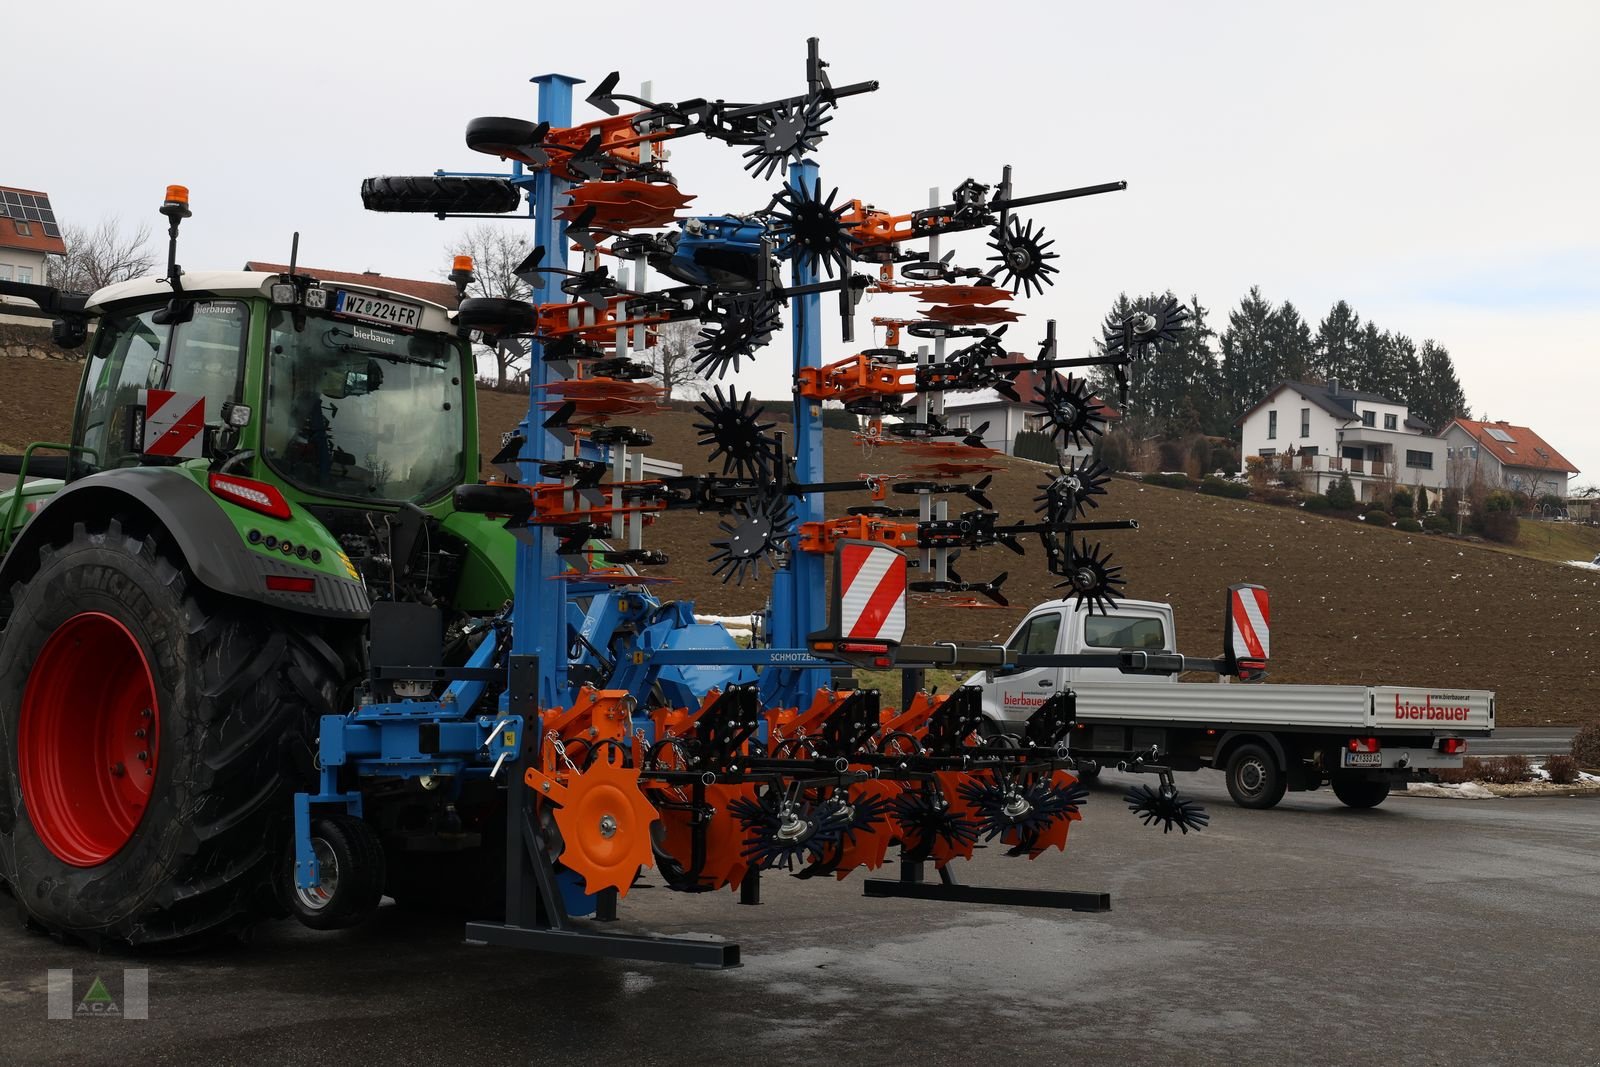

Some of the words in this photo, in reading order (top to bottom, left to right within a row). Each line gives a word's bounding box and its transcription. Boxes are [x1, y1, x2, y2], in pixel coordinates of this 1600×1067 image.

[346, 295, 366, 314] WZ
[353, 325, 396, 345] bierbauer
[1395, 693, 1470, 721] bierbauer
